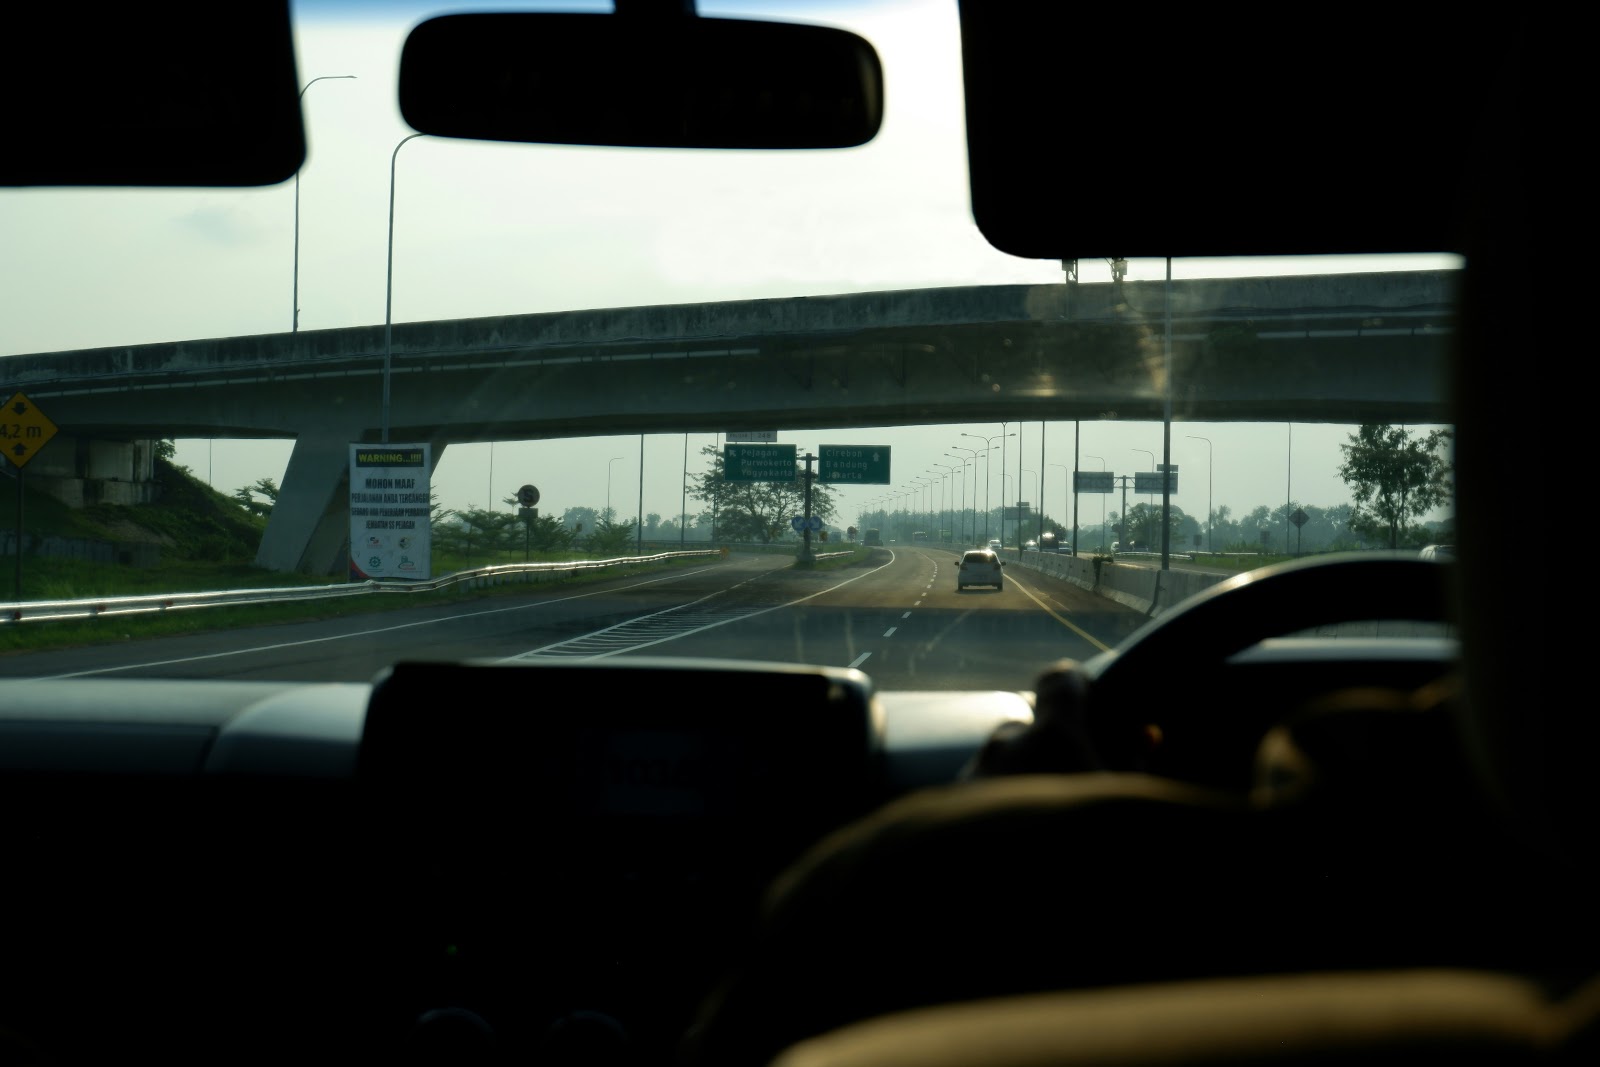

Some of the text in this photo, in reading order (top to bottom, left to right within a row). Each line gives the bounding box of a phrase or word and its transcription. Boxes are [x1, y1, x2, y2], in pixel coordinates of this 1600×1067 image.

[27, 426, 41, 438] m
[741, 449, 778, 458] Pejagan
[826, 449, 862, 457] Cirebon
[741, 459, 792, 467] Purwokerto
[826, 461, 867, 470] Bandung
[741, 469, 793, 477] Yogyakarta
[826, 471, 862, 479] Jakarta
[365, 478, 416, 489] MOHON MAAF
[351, 493, 382, 504] PERJALANAN
[384, 493, 398, 504] ANDA
